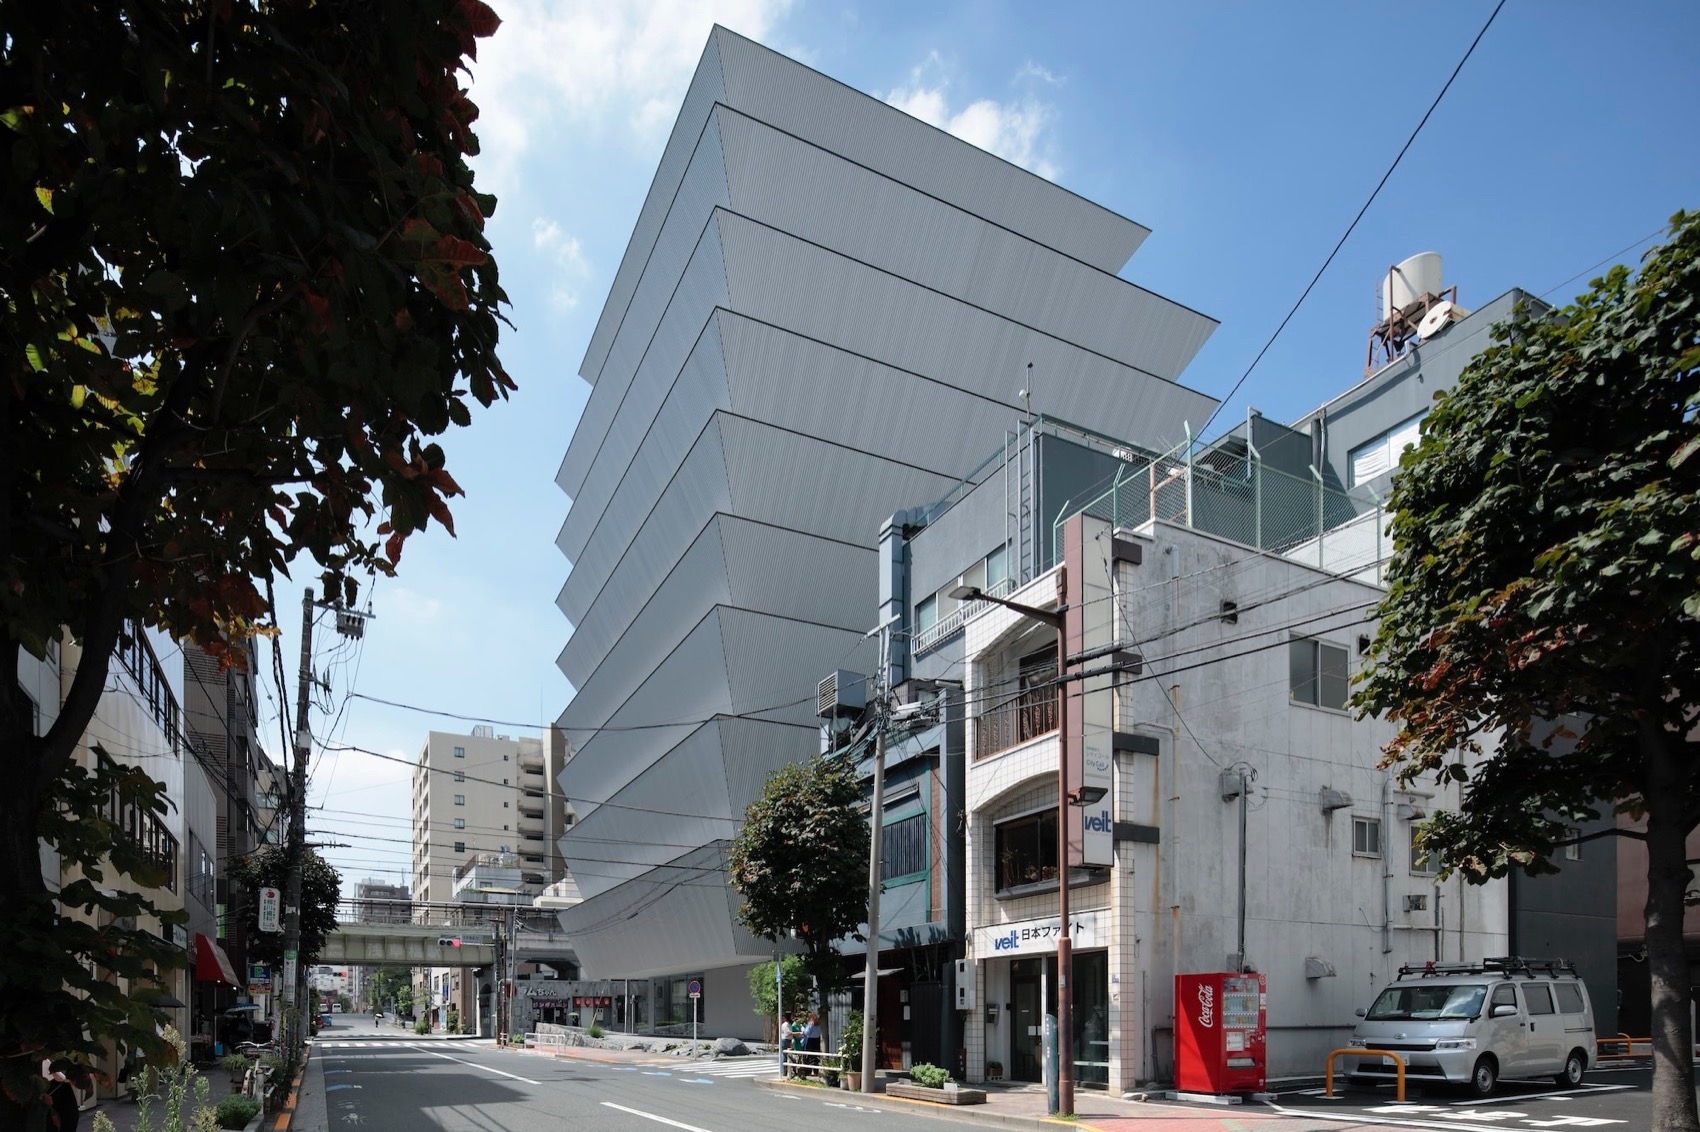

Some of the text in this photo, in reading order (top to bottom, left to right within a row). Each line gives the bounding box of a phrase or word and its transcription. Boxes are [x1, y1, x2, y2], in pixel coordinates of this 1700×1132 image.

[1085, 810, 1111, 833] veit
[995, 930, 1019, 950] veit
[1022, 921, 1085, 940] 日本ファト
